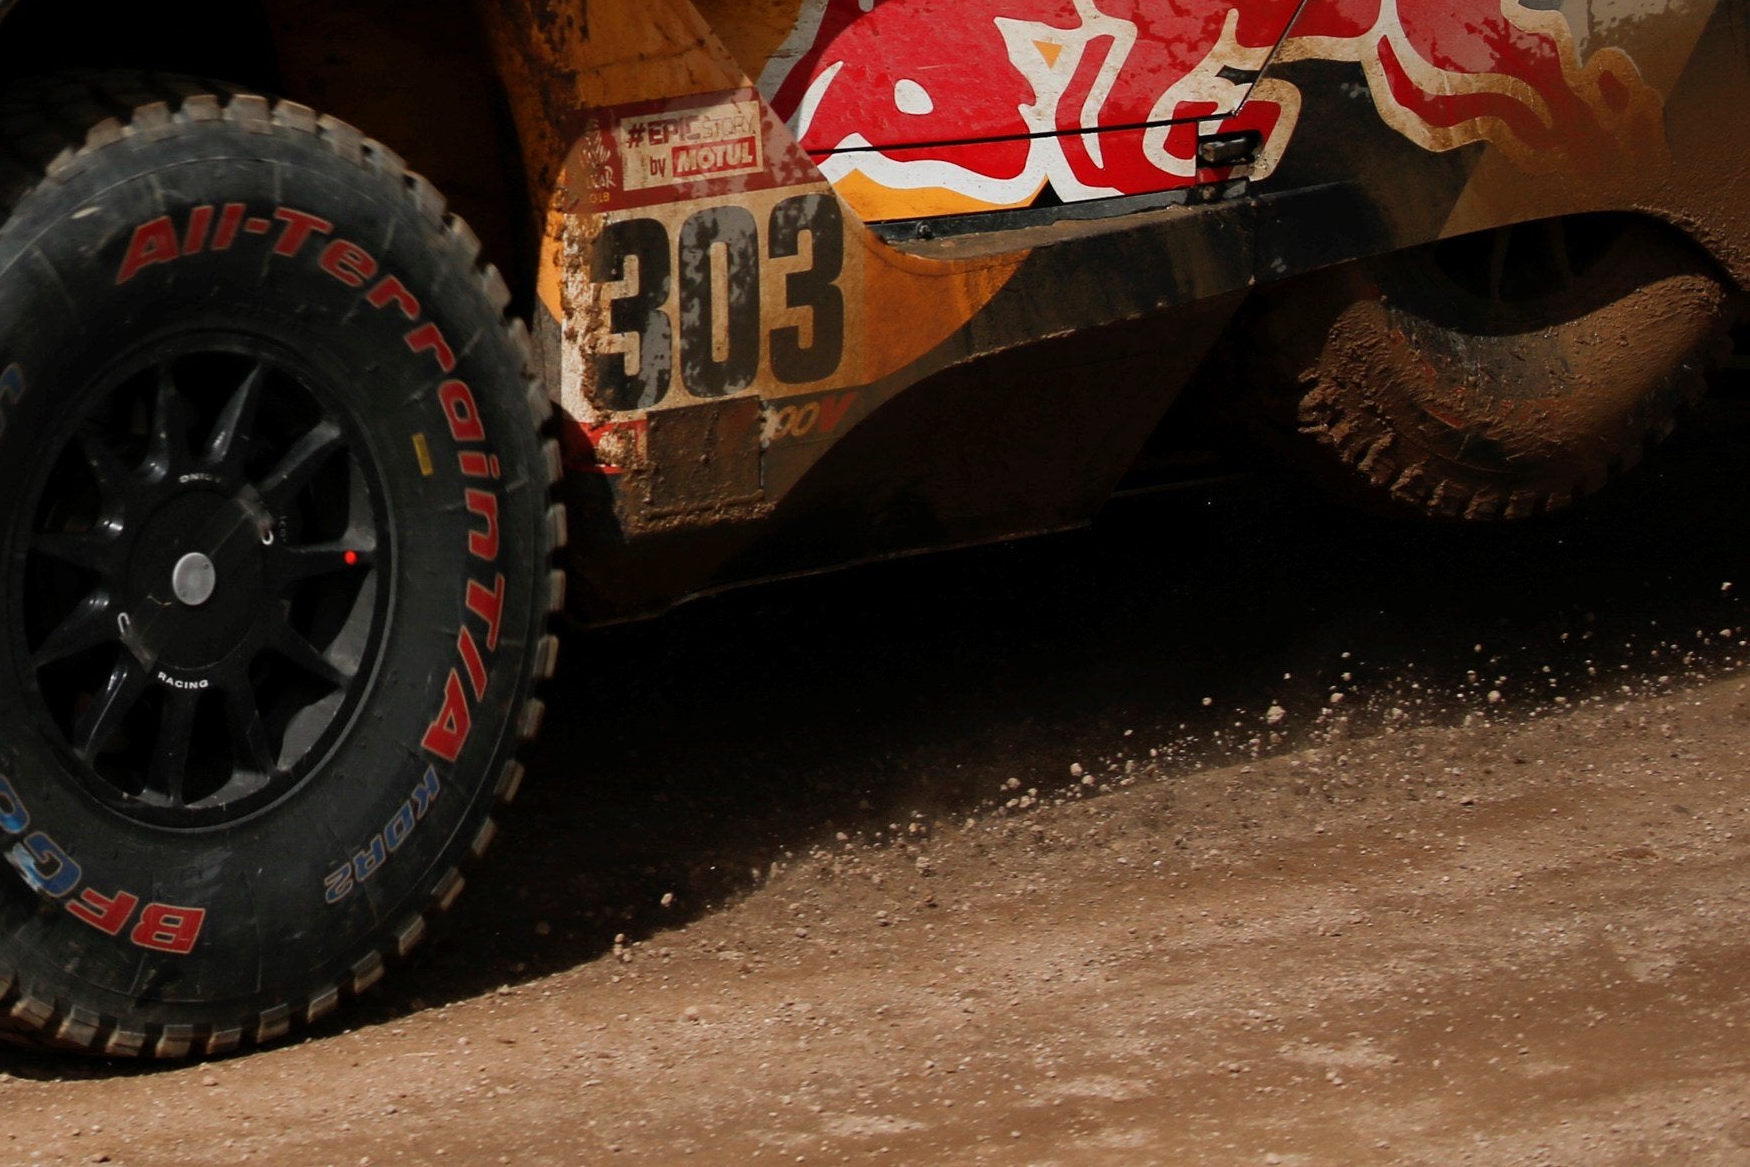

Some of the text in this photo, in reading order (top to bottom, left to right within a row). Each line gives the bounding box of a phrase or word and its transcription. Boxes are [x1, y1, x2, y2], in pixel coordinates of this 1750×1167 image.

[677, 141, 753, 173] MOTUL
[590, 193, 844, 412] 303
[157, 670, 210, 689] RACING
[323, 764, 441, 905] KDR2
